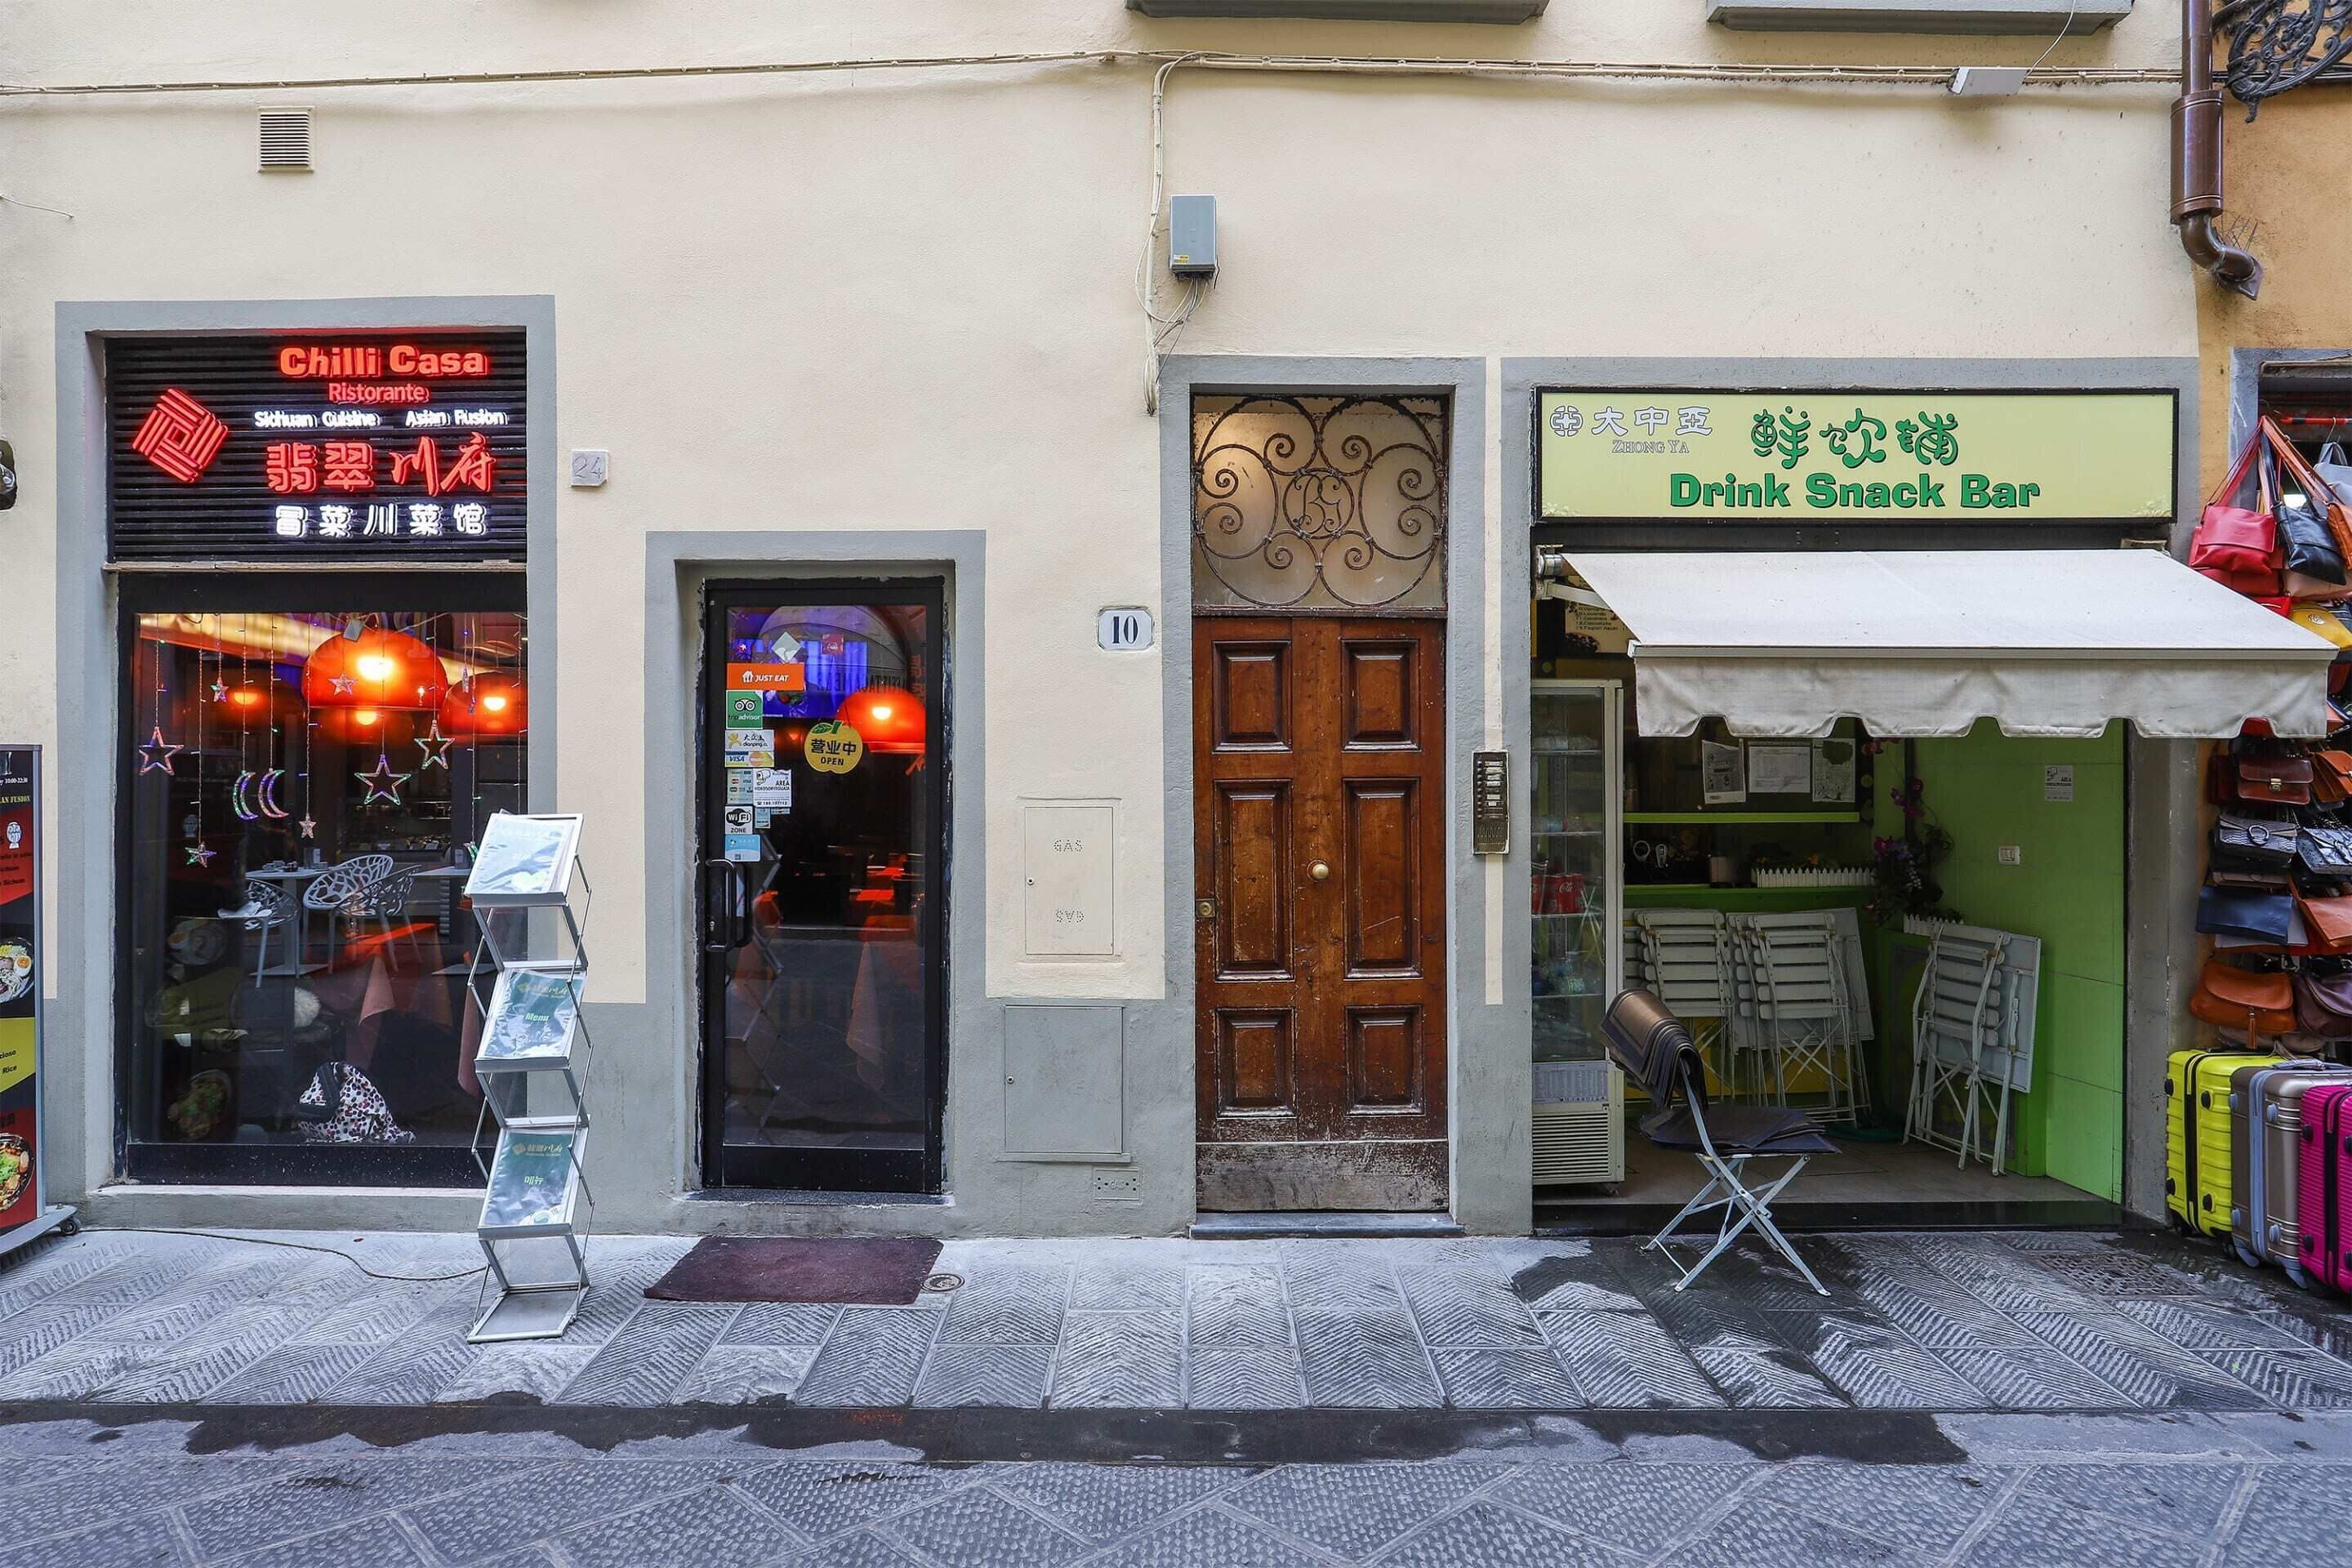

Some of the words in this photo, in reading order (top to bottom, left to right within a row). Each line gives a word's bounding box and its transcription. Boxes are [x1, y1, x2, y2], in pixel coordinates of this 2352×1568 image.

[279, 347, 380, 376] Chilli
[389, 345, 488, 375] Casa
[328, 382, 430, 403] Ristorante
[254, 410, 317, 427] Sichuan
[322, 410, 380, 426] Cuisine
[405, 410, 450, 427] Asian
[454, 410, 508, 425] Fusion
[1612, 439, 1665, 453] ZHONG
[1668, 439, 1689, 453] YA
[266, 431, 497, 497] 翡翠川府
[574, 456, 604, 479] 24
[1670, 473, 1791, 508] Drink
[1805, 473, 1945, 508] Snack
[1960, 474, 2040, 508] Bar
[275, 503, 487, 537] 冒菜川菜馆
[1112, 615, 1138, 644] 10
[755, 675, 774, 683] JUST
[811, 738, 857, 756] 营业中
[821, 757, 844, 766] OPEN
[1054, 839, 1084, 852] GAS
[524, 1012, 550, 1022] Menu
[2, 1065, 17, 1074] Rice
[523, 1175, 545, 1185] 메뉴
